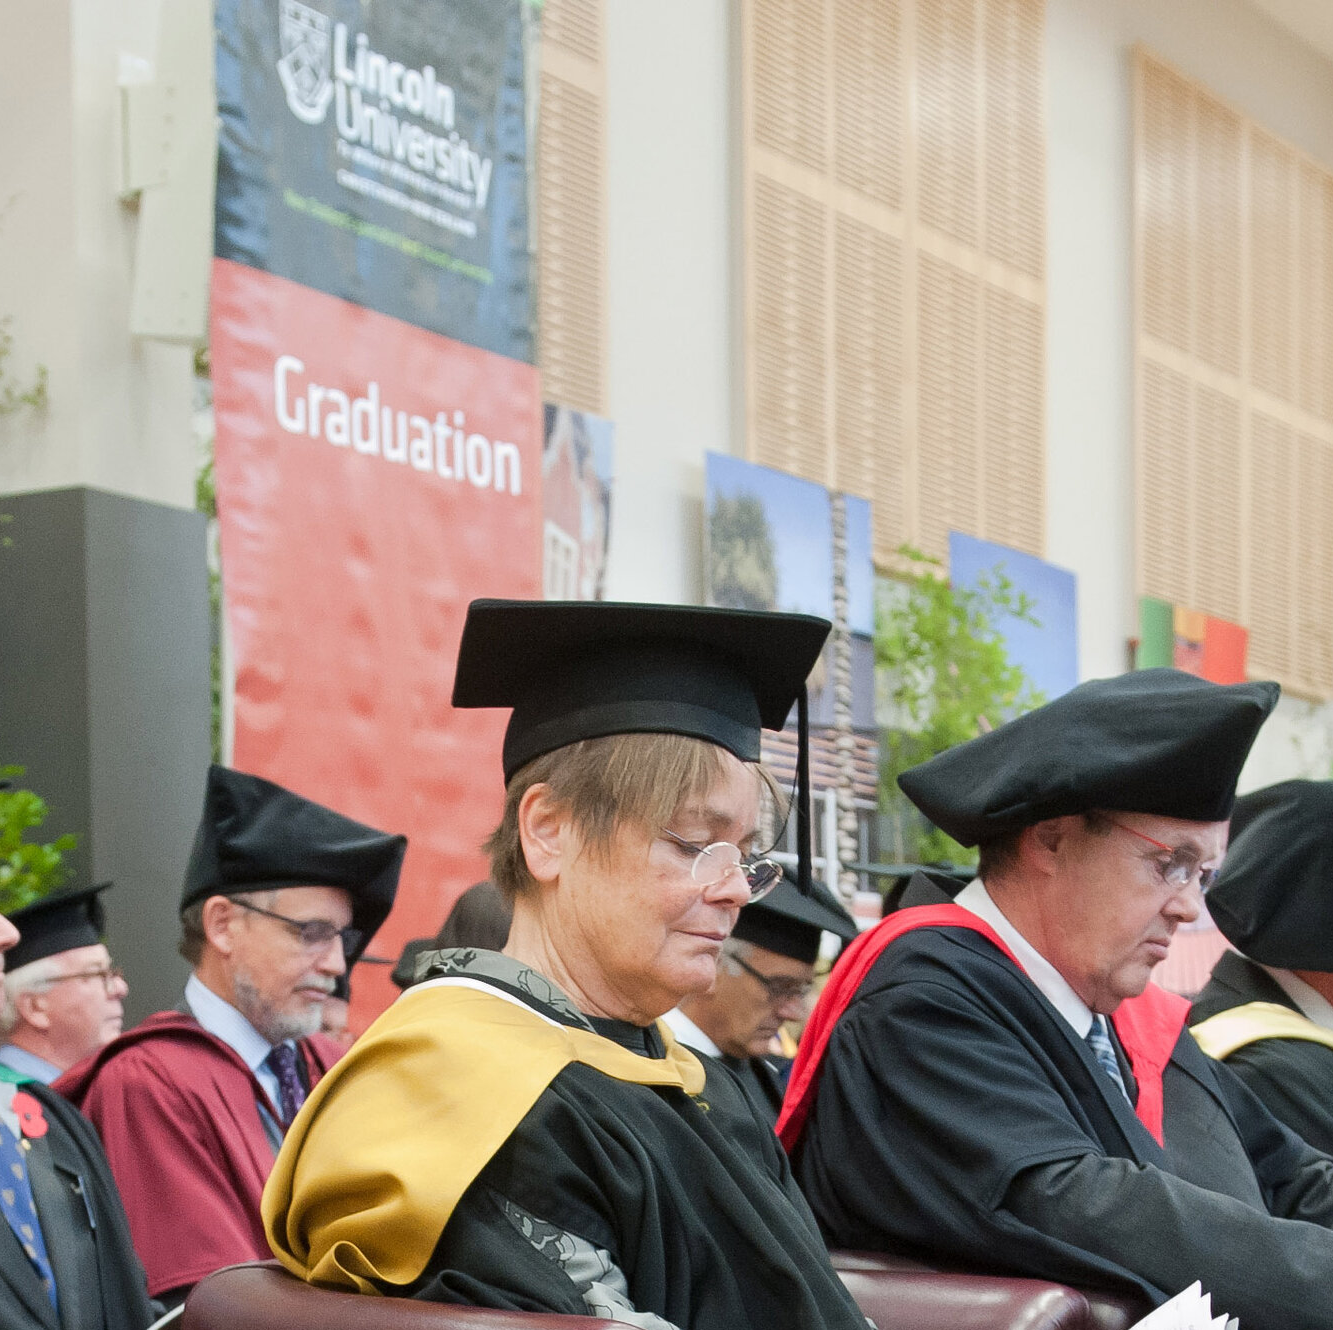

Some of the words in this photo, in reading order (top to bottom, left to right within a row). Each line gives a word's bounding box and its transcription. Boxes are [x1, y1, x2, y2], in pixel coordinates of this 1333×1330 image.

[334, 23, 455, 129] Lincoln
[335, 79, 492, 210] University
[274, 355, 522, 496] Graduation
